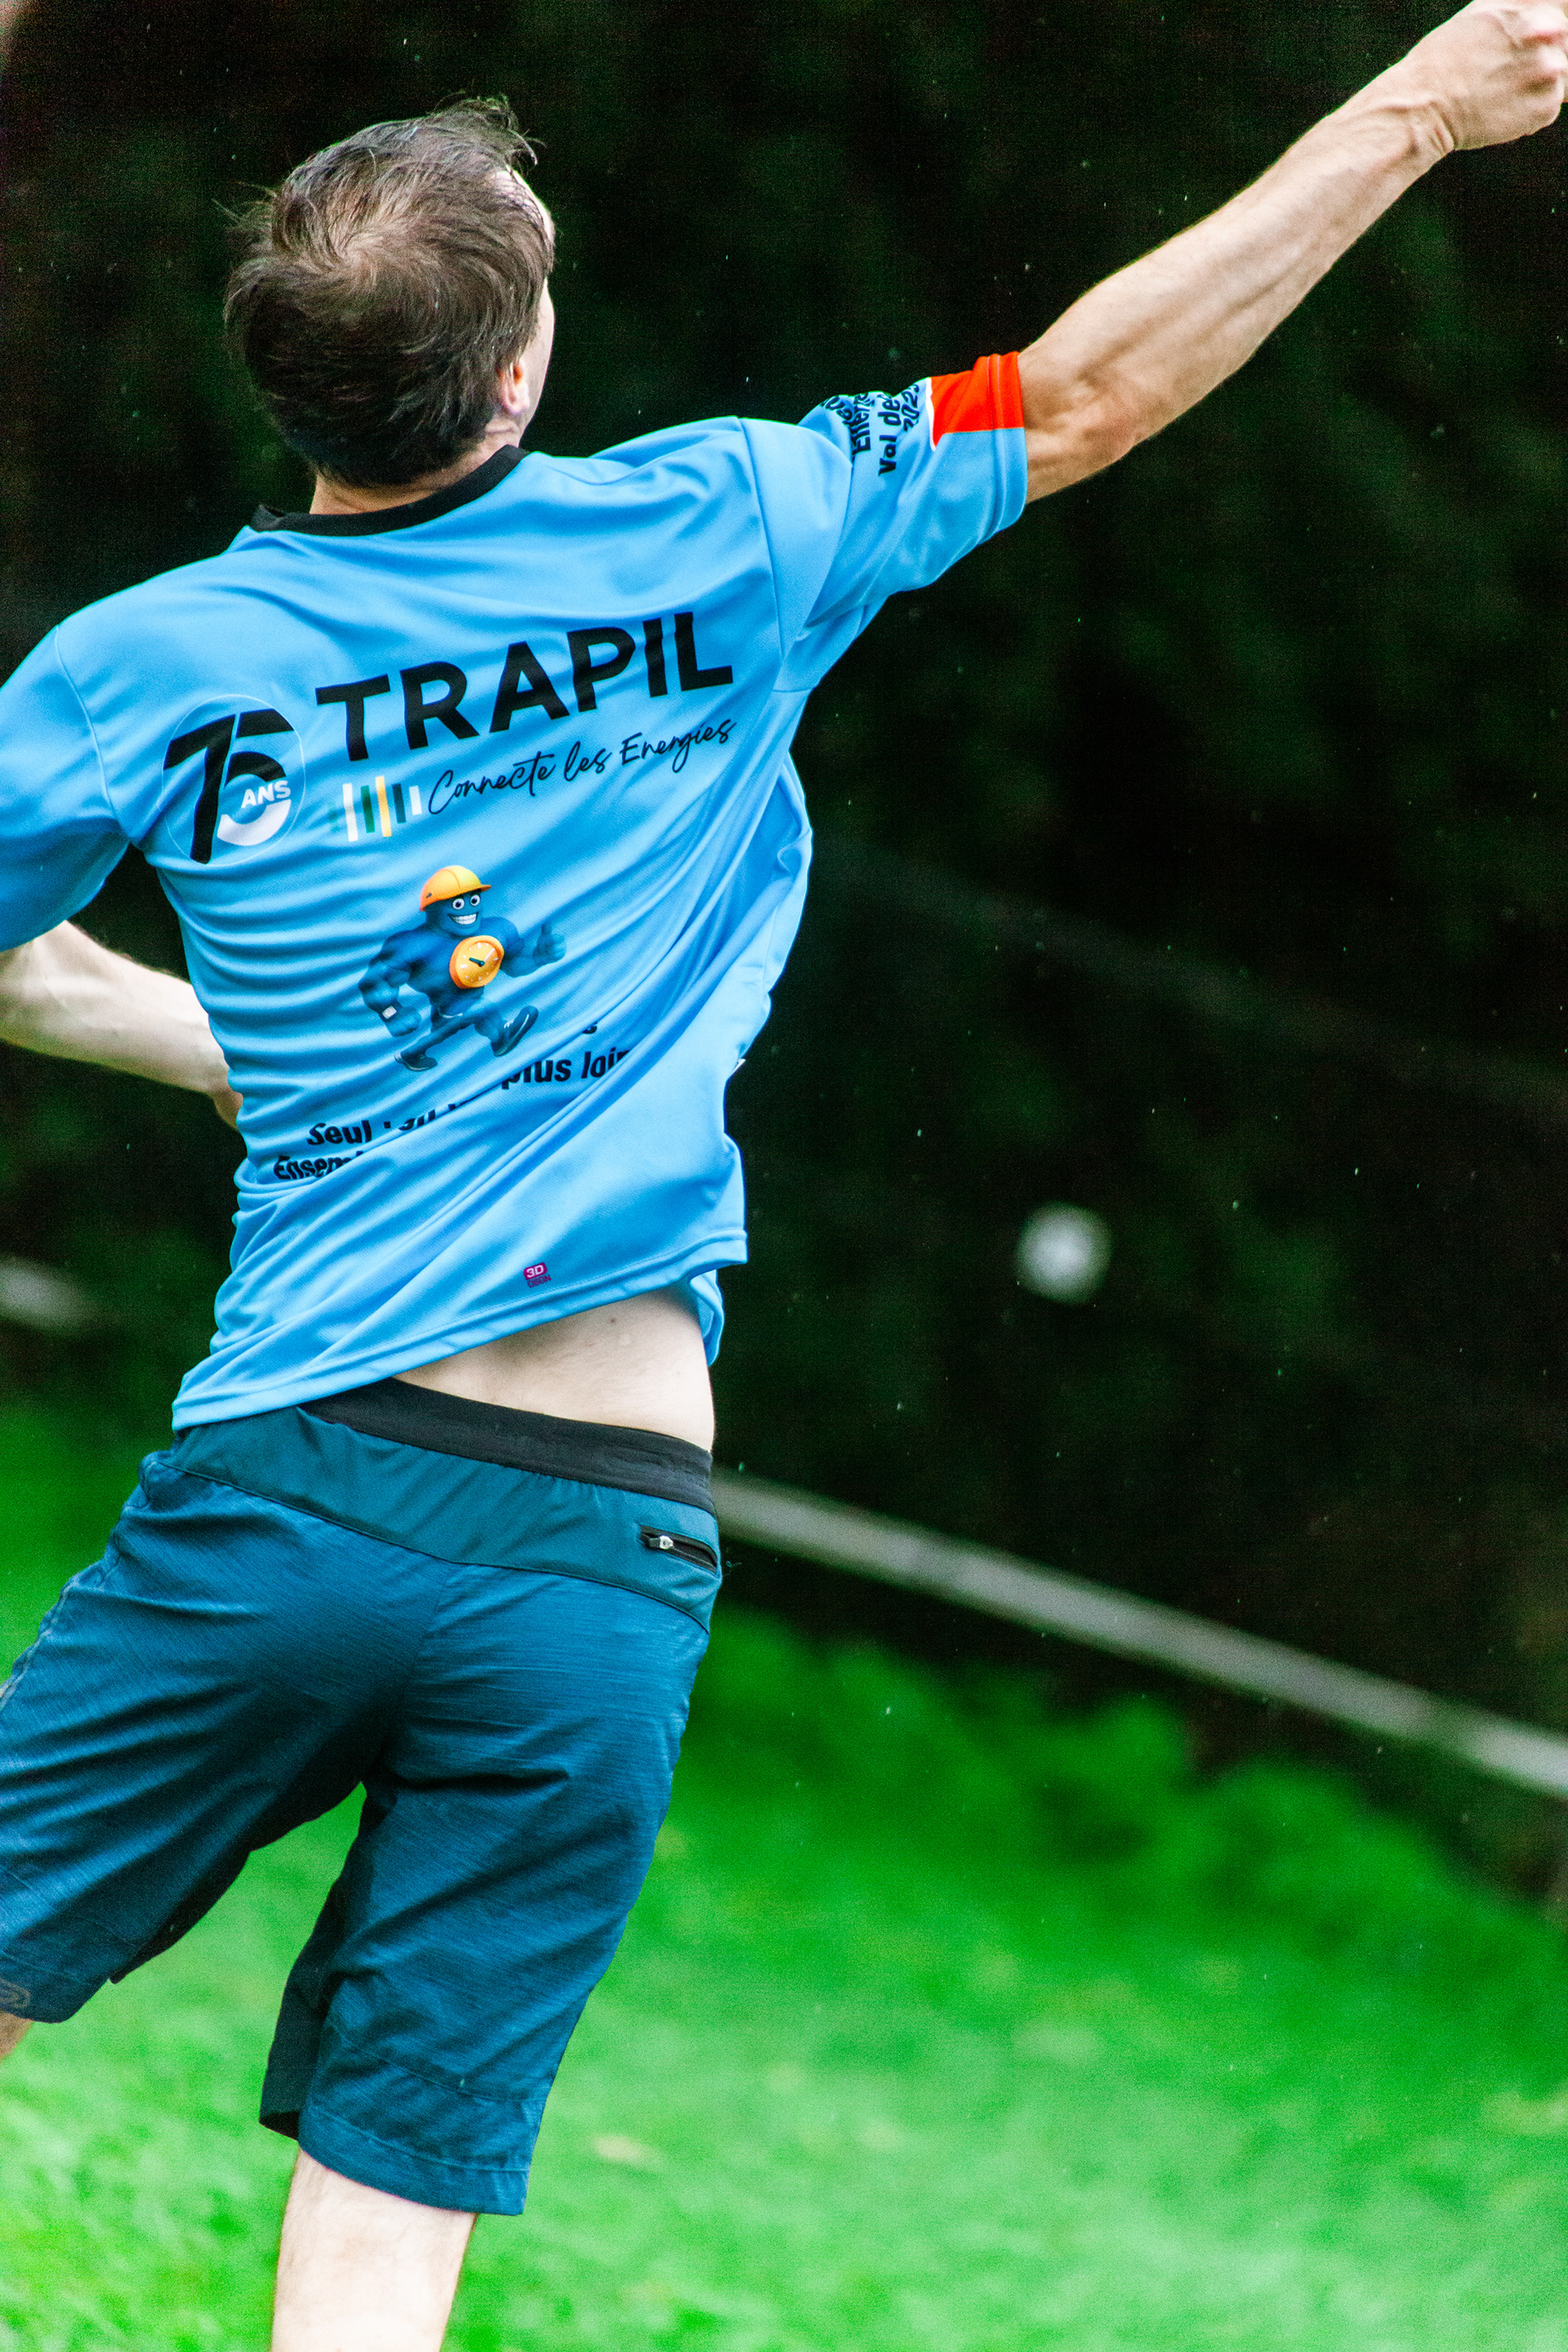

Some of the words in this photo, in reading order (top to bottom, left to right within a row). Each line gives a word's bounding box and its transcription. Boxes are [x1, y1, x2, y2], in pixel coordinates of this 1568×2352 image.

[878, 399, 902, 426] de
[878, 434, 898, 476] Val
[315, 612, 733, 761] TRAPIL
[163, 708, 295, 866] 75
[428, 751, 557, 815] Connecte
[564, 741, 612, 782] les
[619, 719, 737, 773] Energies
[241, 780, 292, 808] ANS
[274, 1150, 364, 1178] Ensem
[501, 1058, 572, 1090] plus
[306, 1120, 372, 1145] Seul
[526, 1264, 545, 1278] 3D
